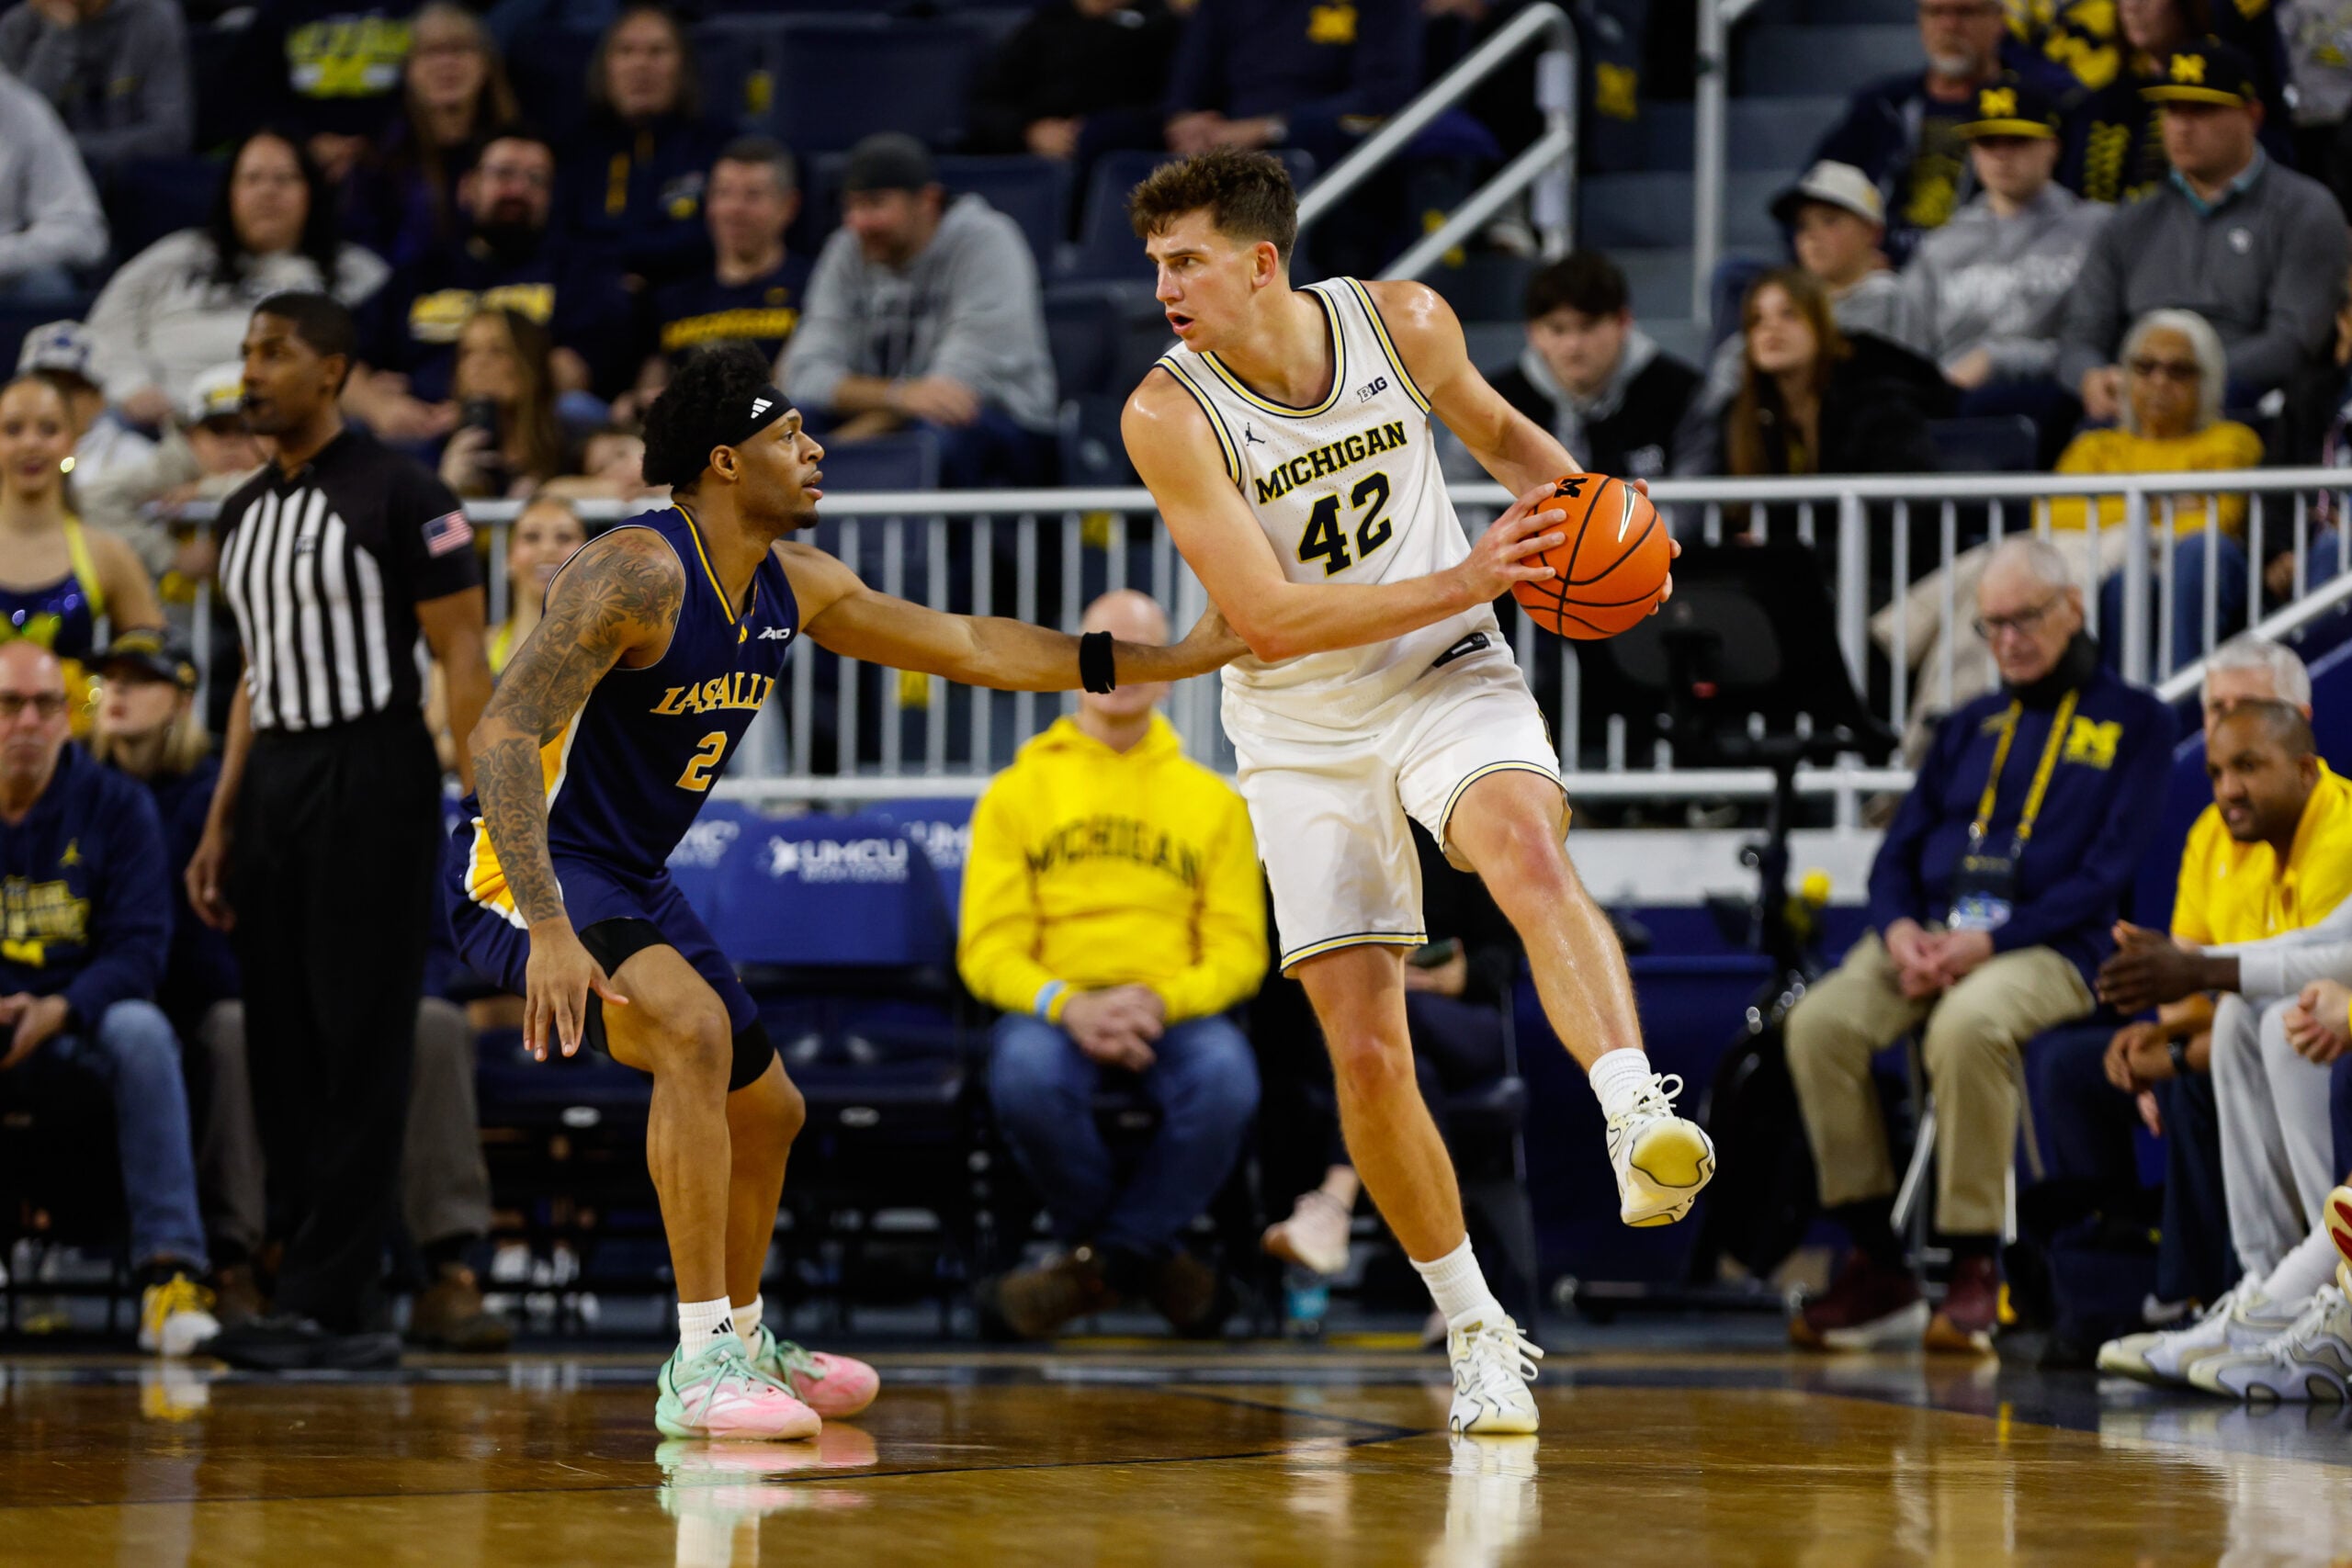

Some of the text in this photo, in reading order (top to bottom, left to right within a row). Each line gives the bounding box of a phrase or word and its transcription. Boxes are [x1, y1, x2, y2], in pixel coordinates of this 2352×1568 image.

[1254, 421, 1408, 505] MICHIGAN
[1296, 471, 1393, 579] 42
[675, 730, 728, 792] 2
[2065, 715, 2123, 759] M
[799, 838, 909, 864] UMCU
[1023, 814, 1204, 887] MICHIGAN
